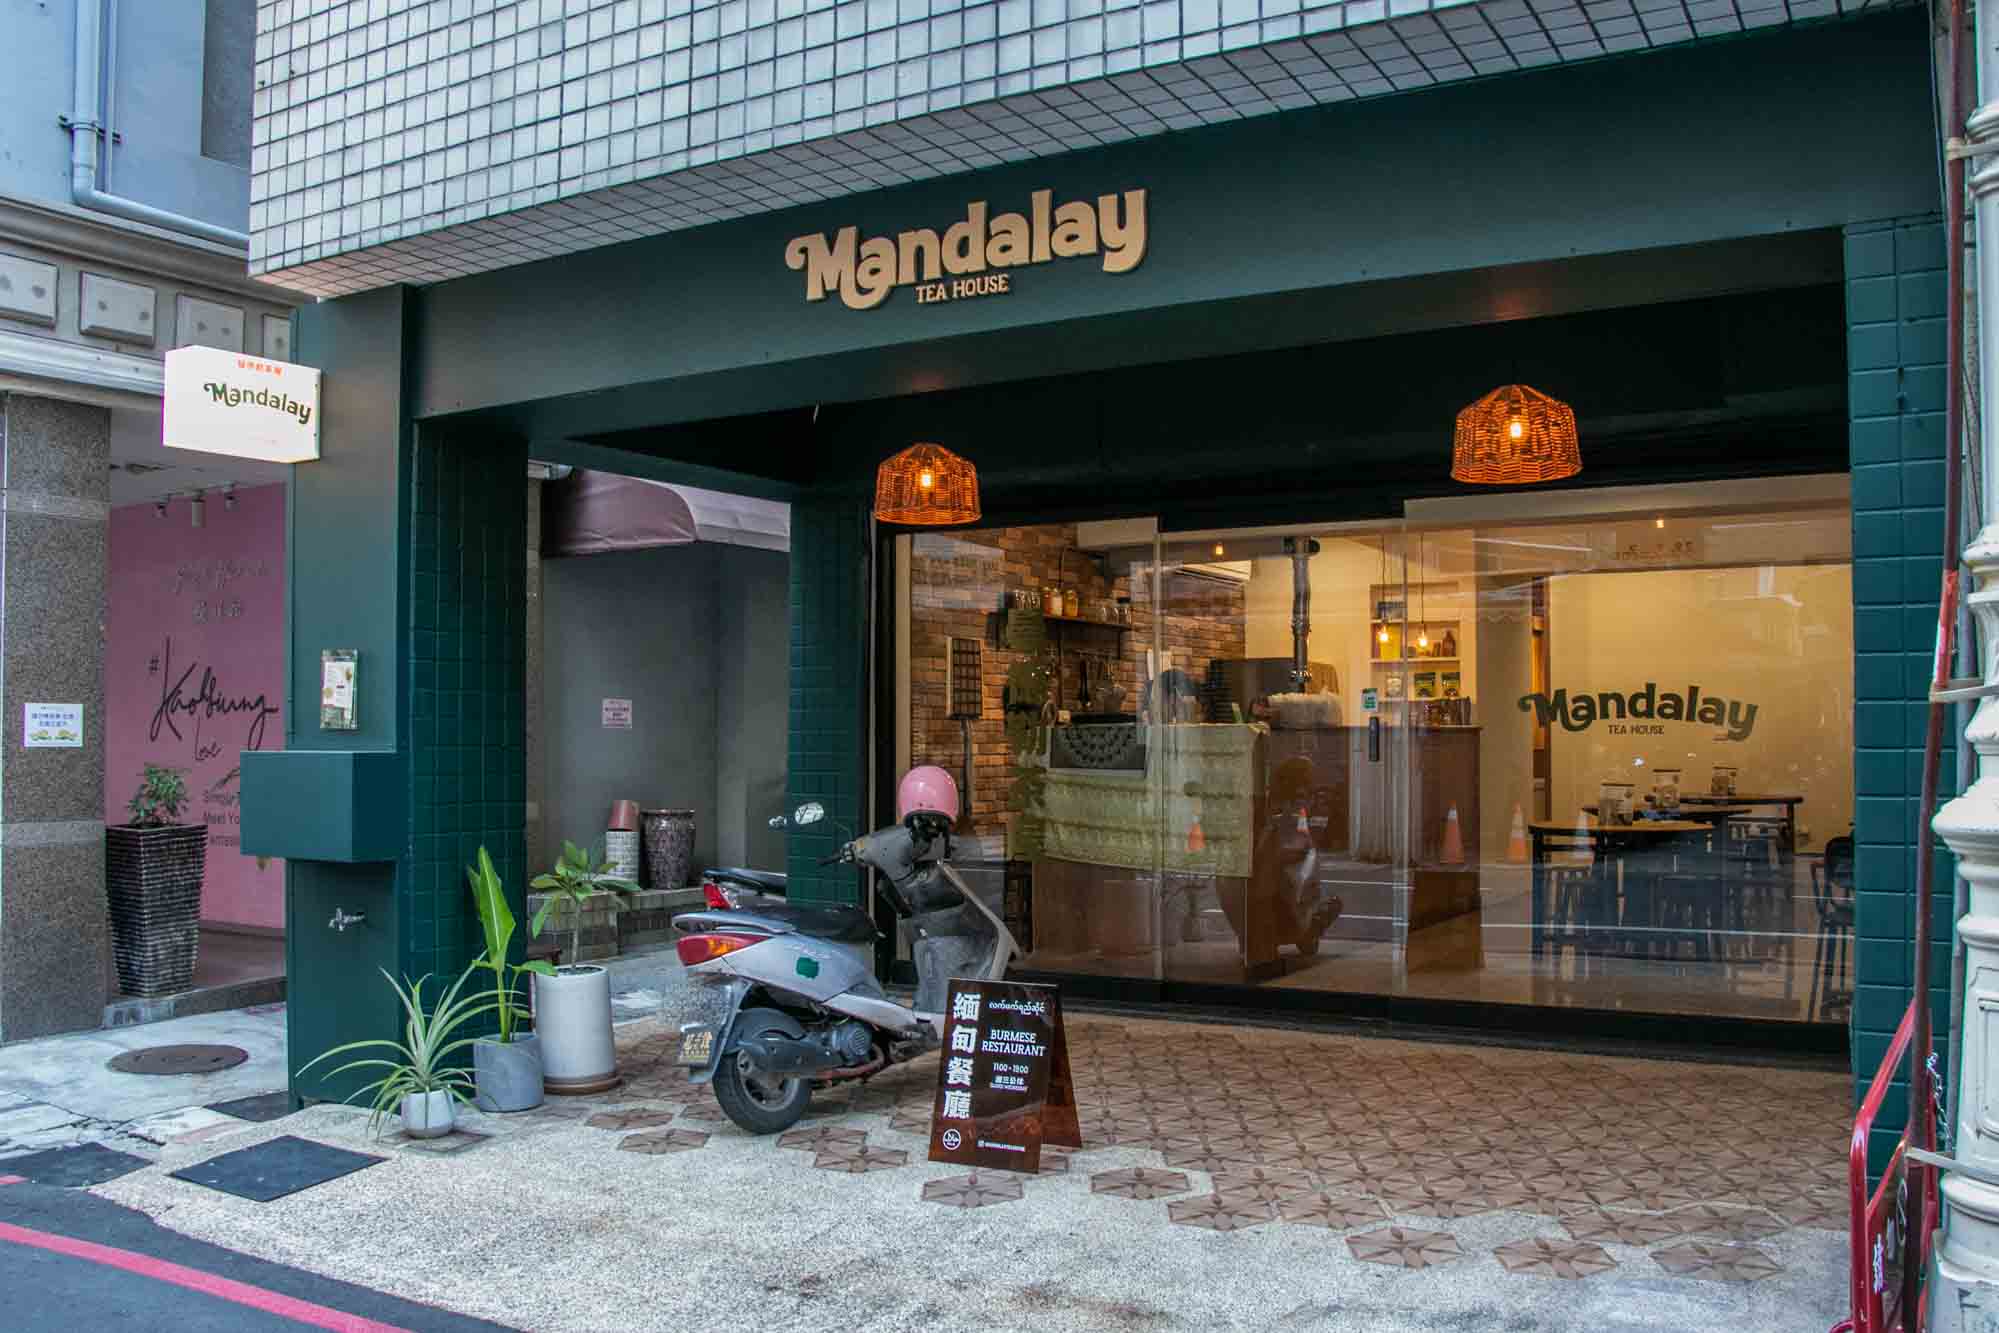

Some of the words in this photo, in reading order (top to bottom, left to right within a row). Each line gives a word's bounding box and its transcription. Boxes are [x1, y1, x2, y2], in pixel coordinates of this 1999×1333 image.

[785, 188, 1148, 310] Mandalay
[915, 283, 946, 303] TEA
[953, 273, 1010, 298] HOUSE
[204, 383, 312, 425] Mandalay
[1517, 683, 1758, 741] Mandalay
[1608, 724, 1627, 735] TEA
[1631, 725, 1665, 735] HOUSE
[982, 1040, 1046, 1056] RESTAURANT
[991, 1029, 1037, 1043] BURMESE
[943, 992, 981, 1119] 緬甸餐廳
